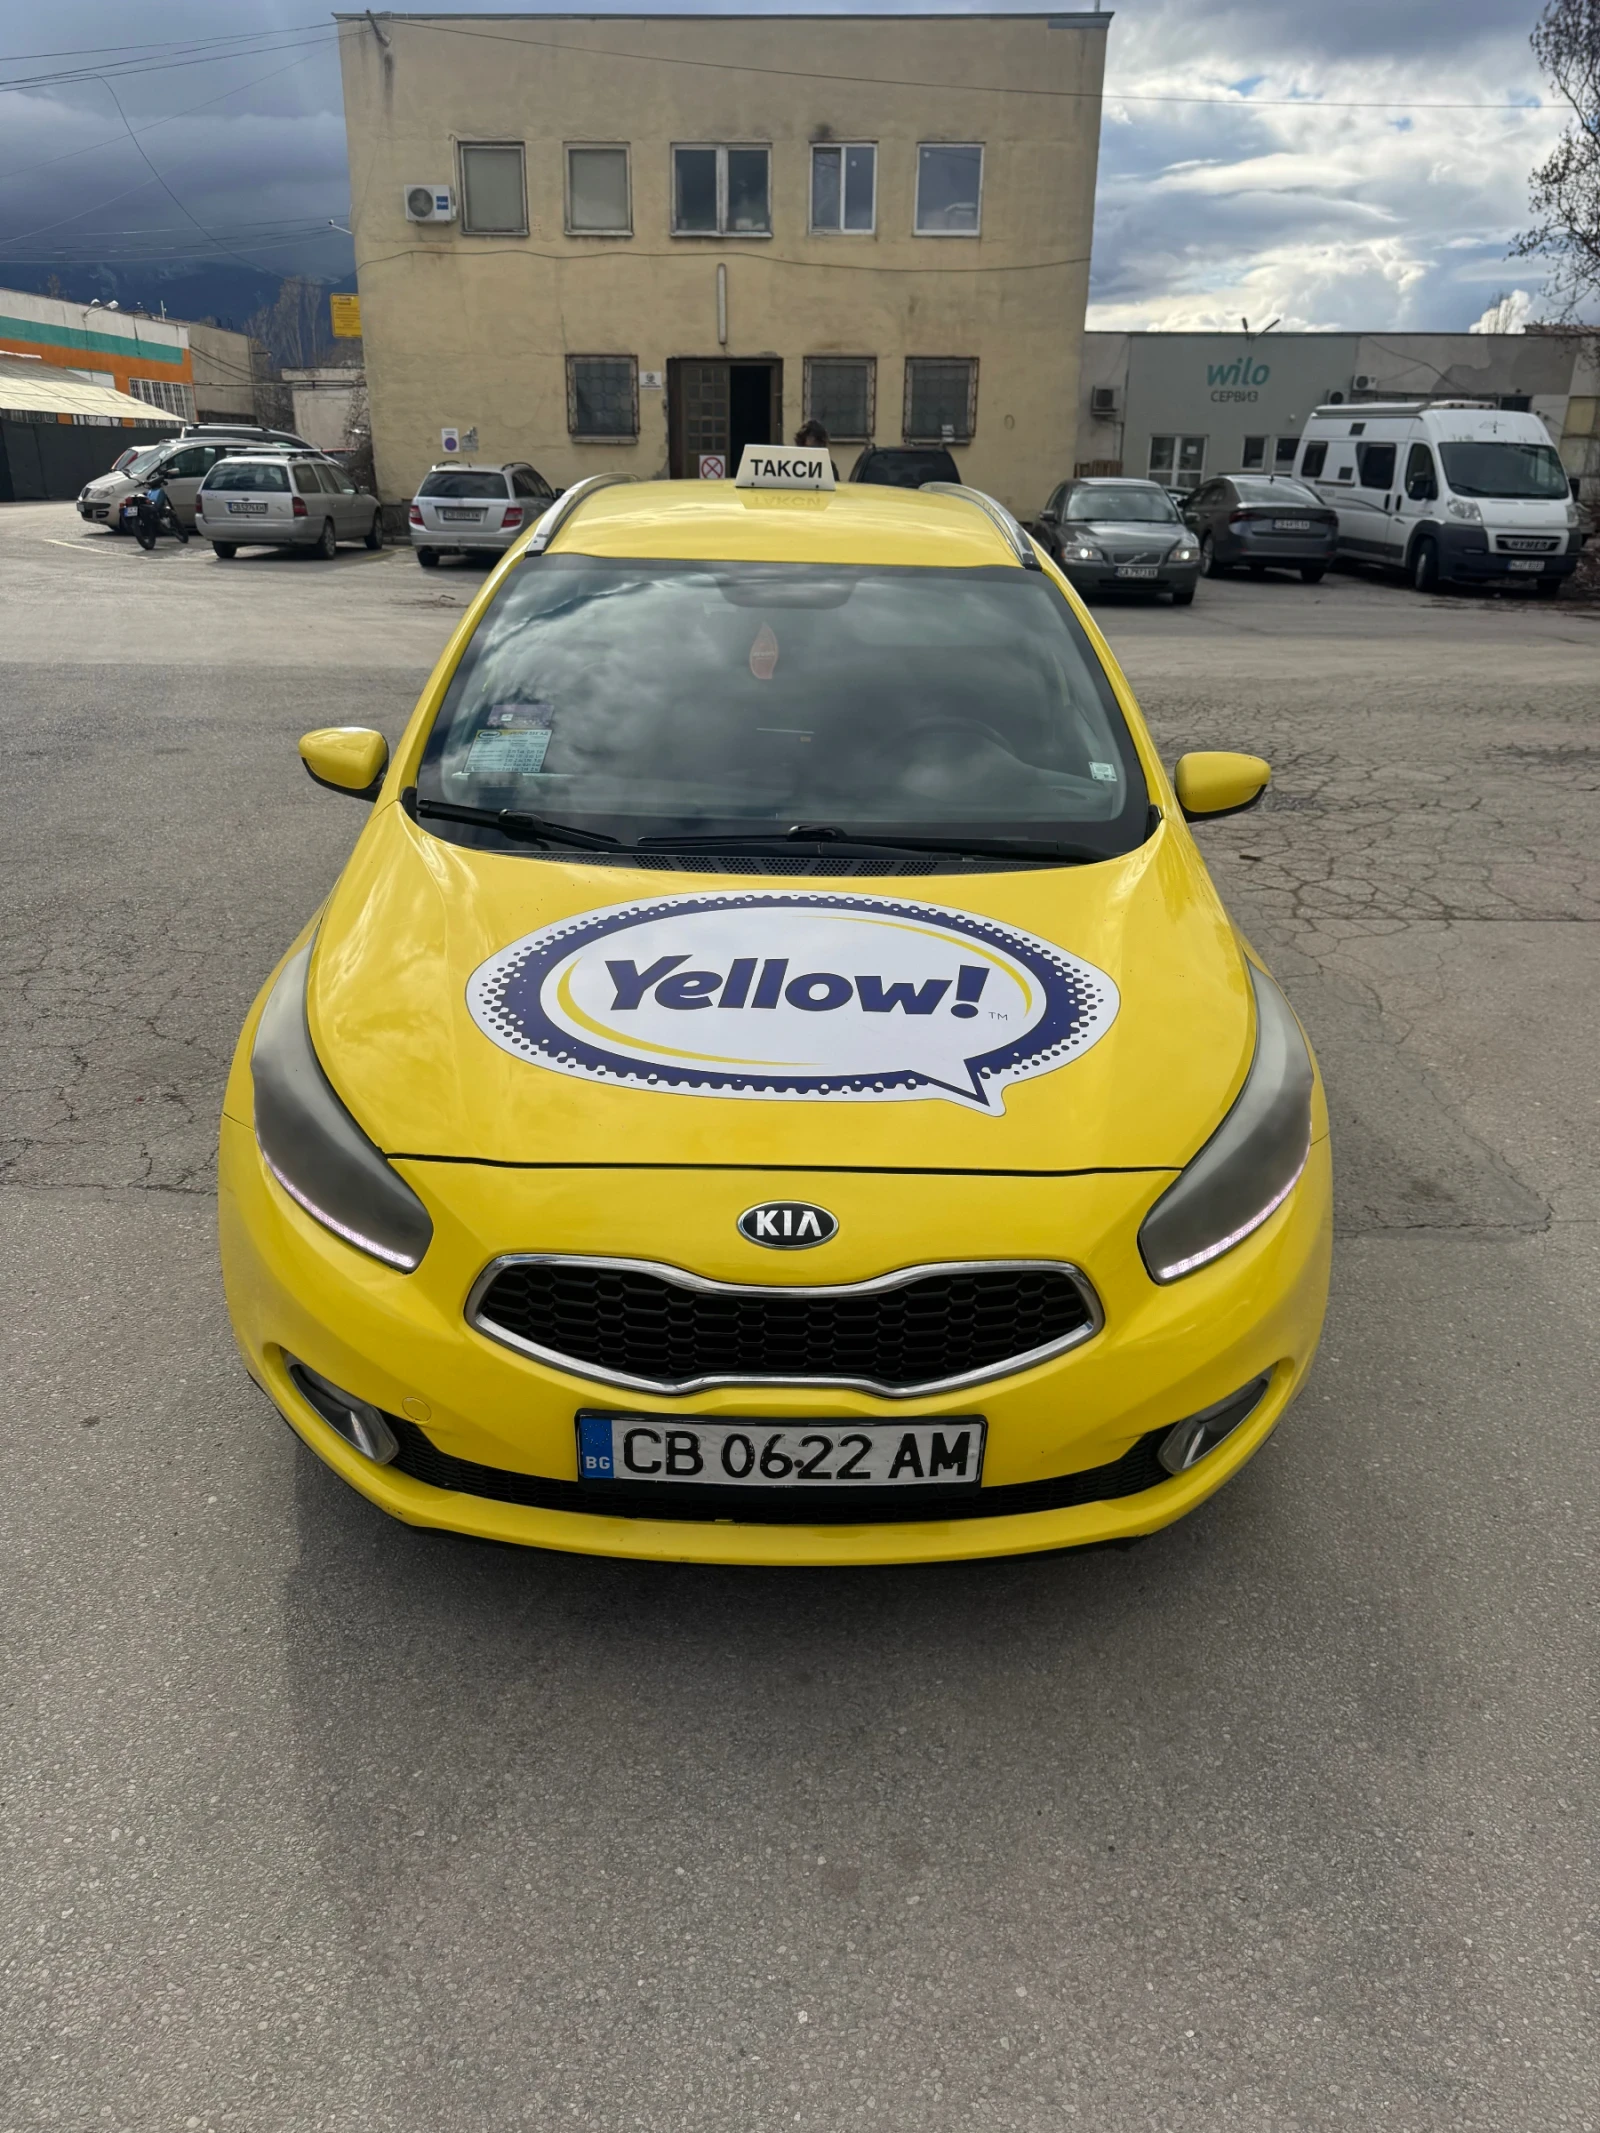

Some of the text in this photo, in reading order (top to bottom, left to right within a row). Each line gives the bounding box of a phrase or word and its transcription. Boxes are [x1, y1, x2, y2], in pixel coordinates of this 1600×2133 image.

[1207, 356, 1270, 386] wilo
[1211, 390, 1258, 402] СЕРВИЗ
[750, 459, 822, 478] ТАКСИ
[605, 954, 1008, 1021] Yellow! TM
[756, 1210, 822, 1237] KIA
[586, 1428, 971, 1479] BG CB 0622 AM
